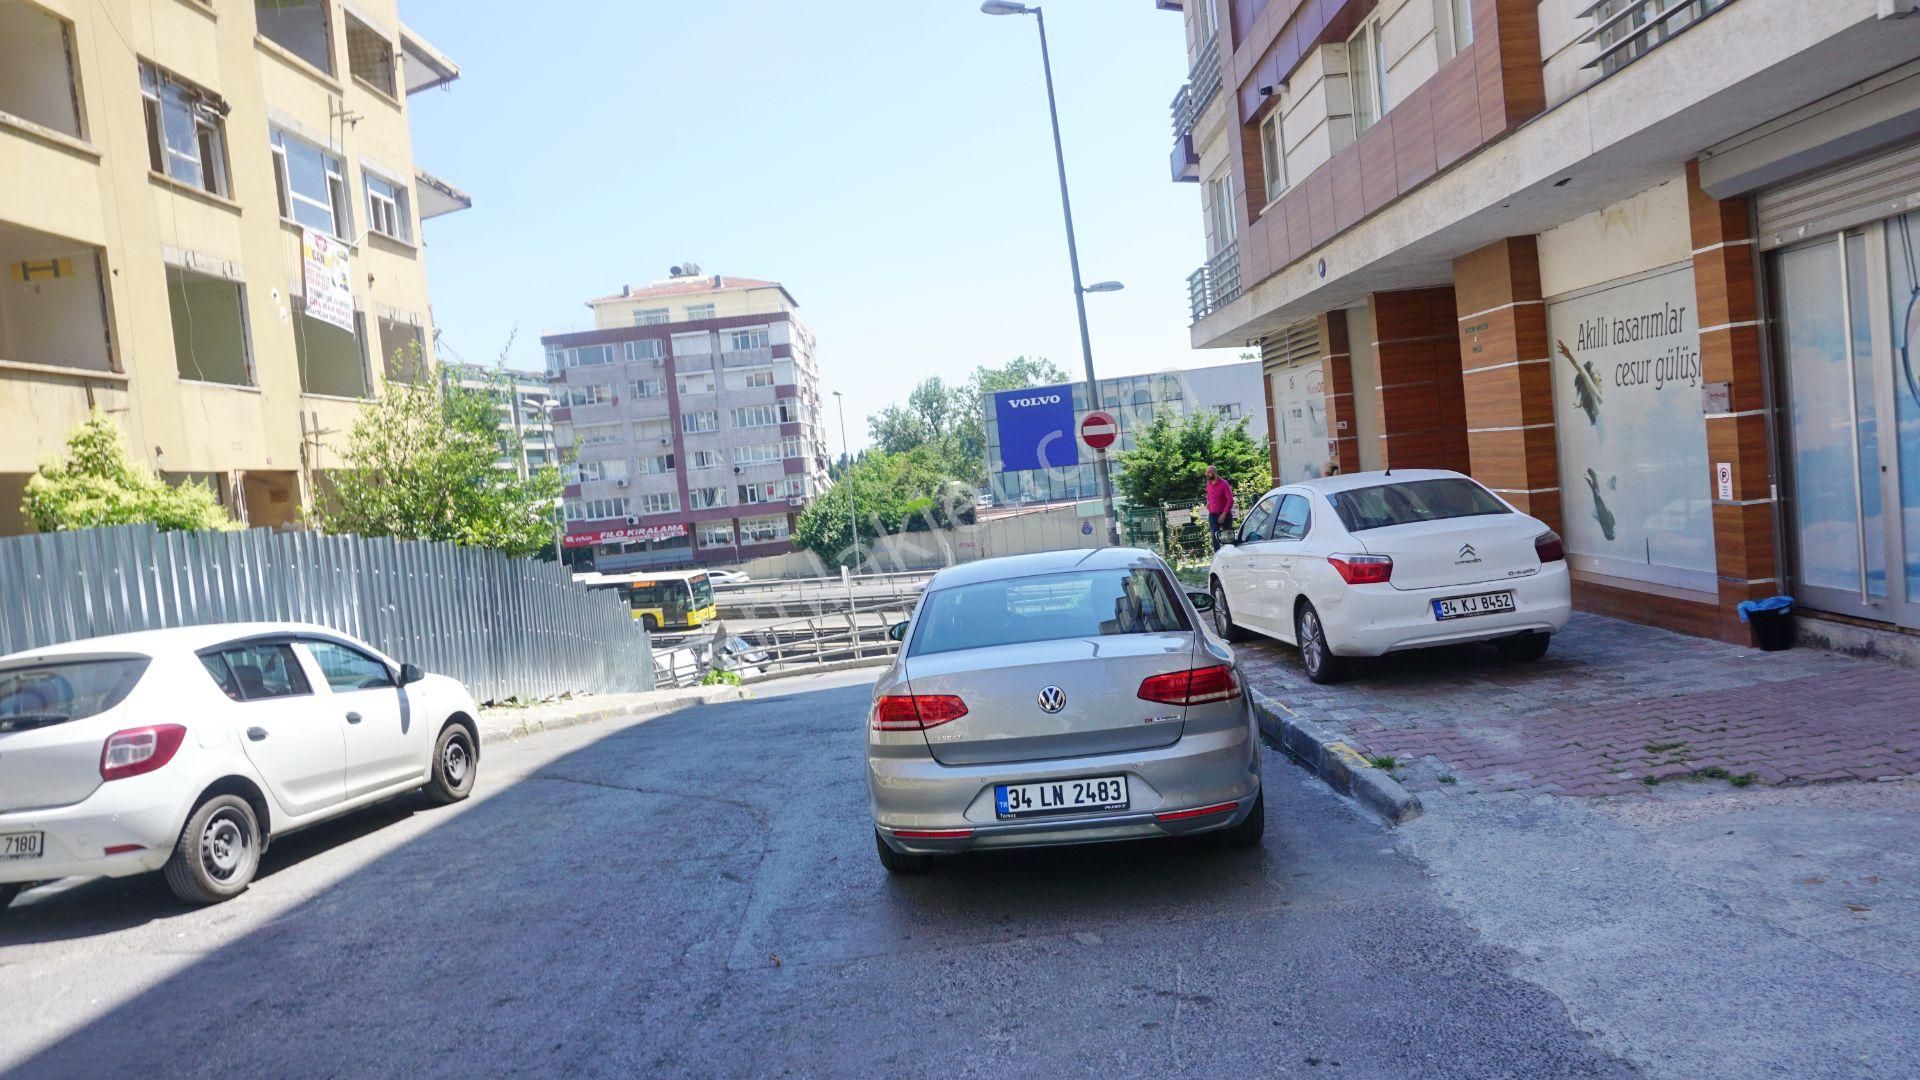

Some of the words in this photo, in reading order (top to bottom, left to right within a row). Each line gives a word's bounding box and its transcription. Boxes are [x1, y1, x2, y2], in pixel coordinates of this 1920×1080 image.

[1577, 319, 1608, 352] Akıllı
[1612, 301, 1686, 346] tasarımlar
[1614, 357, 1652, 387] cesur
[1007, 394, 1061, 409] VOLVO
[1441, 601, 1457, 615] 34
[1461, 598, 1477, 612] KJ
[1480, 594, 1511, 610] 8452
[1008, 788, 1032, 810] 34
[1040, 784, 1064, 807] LN
[1072, 780, 1122, 805] 2483
[5, 835, 37, 854] 7180
